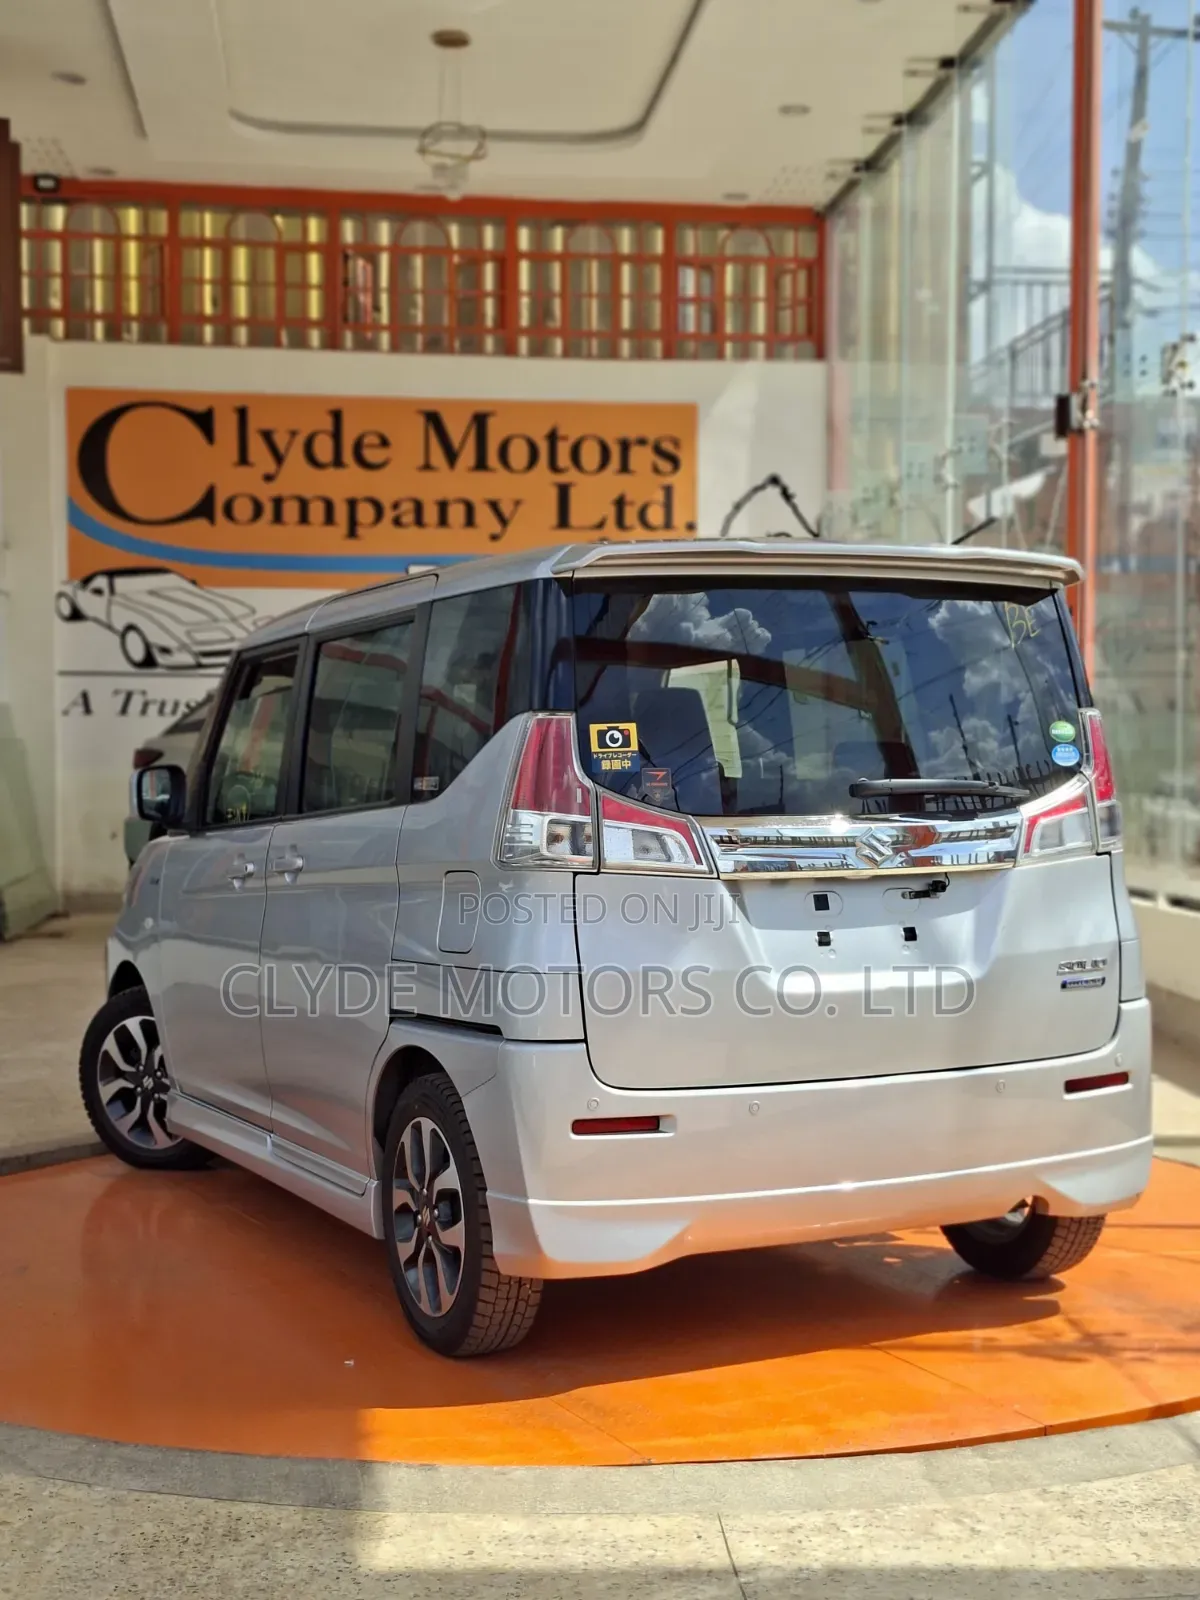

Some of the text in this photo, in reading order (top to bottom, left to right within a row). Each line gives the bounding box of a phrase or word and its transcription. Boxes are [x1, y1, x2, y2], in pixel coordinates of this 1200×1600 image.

[416, 408, 683, 477] Motors
[552, 481, 698, 532] Ltd.
[62, 689, 93, 717] A
